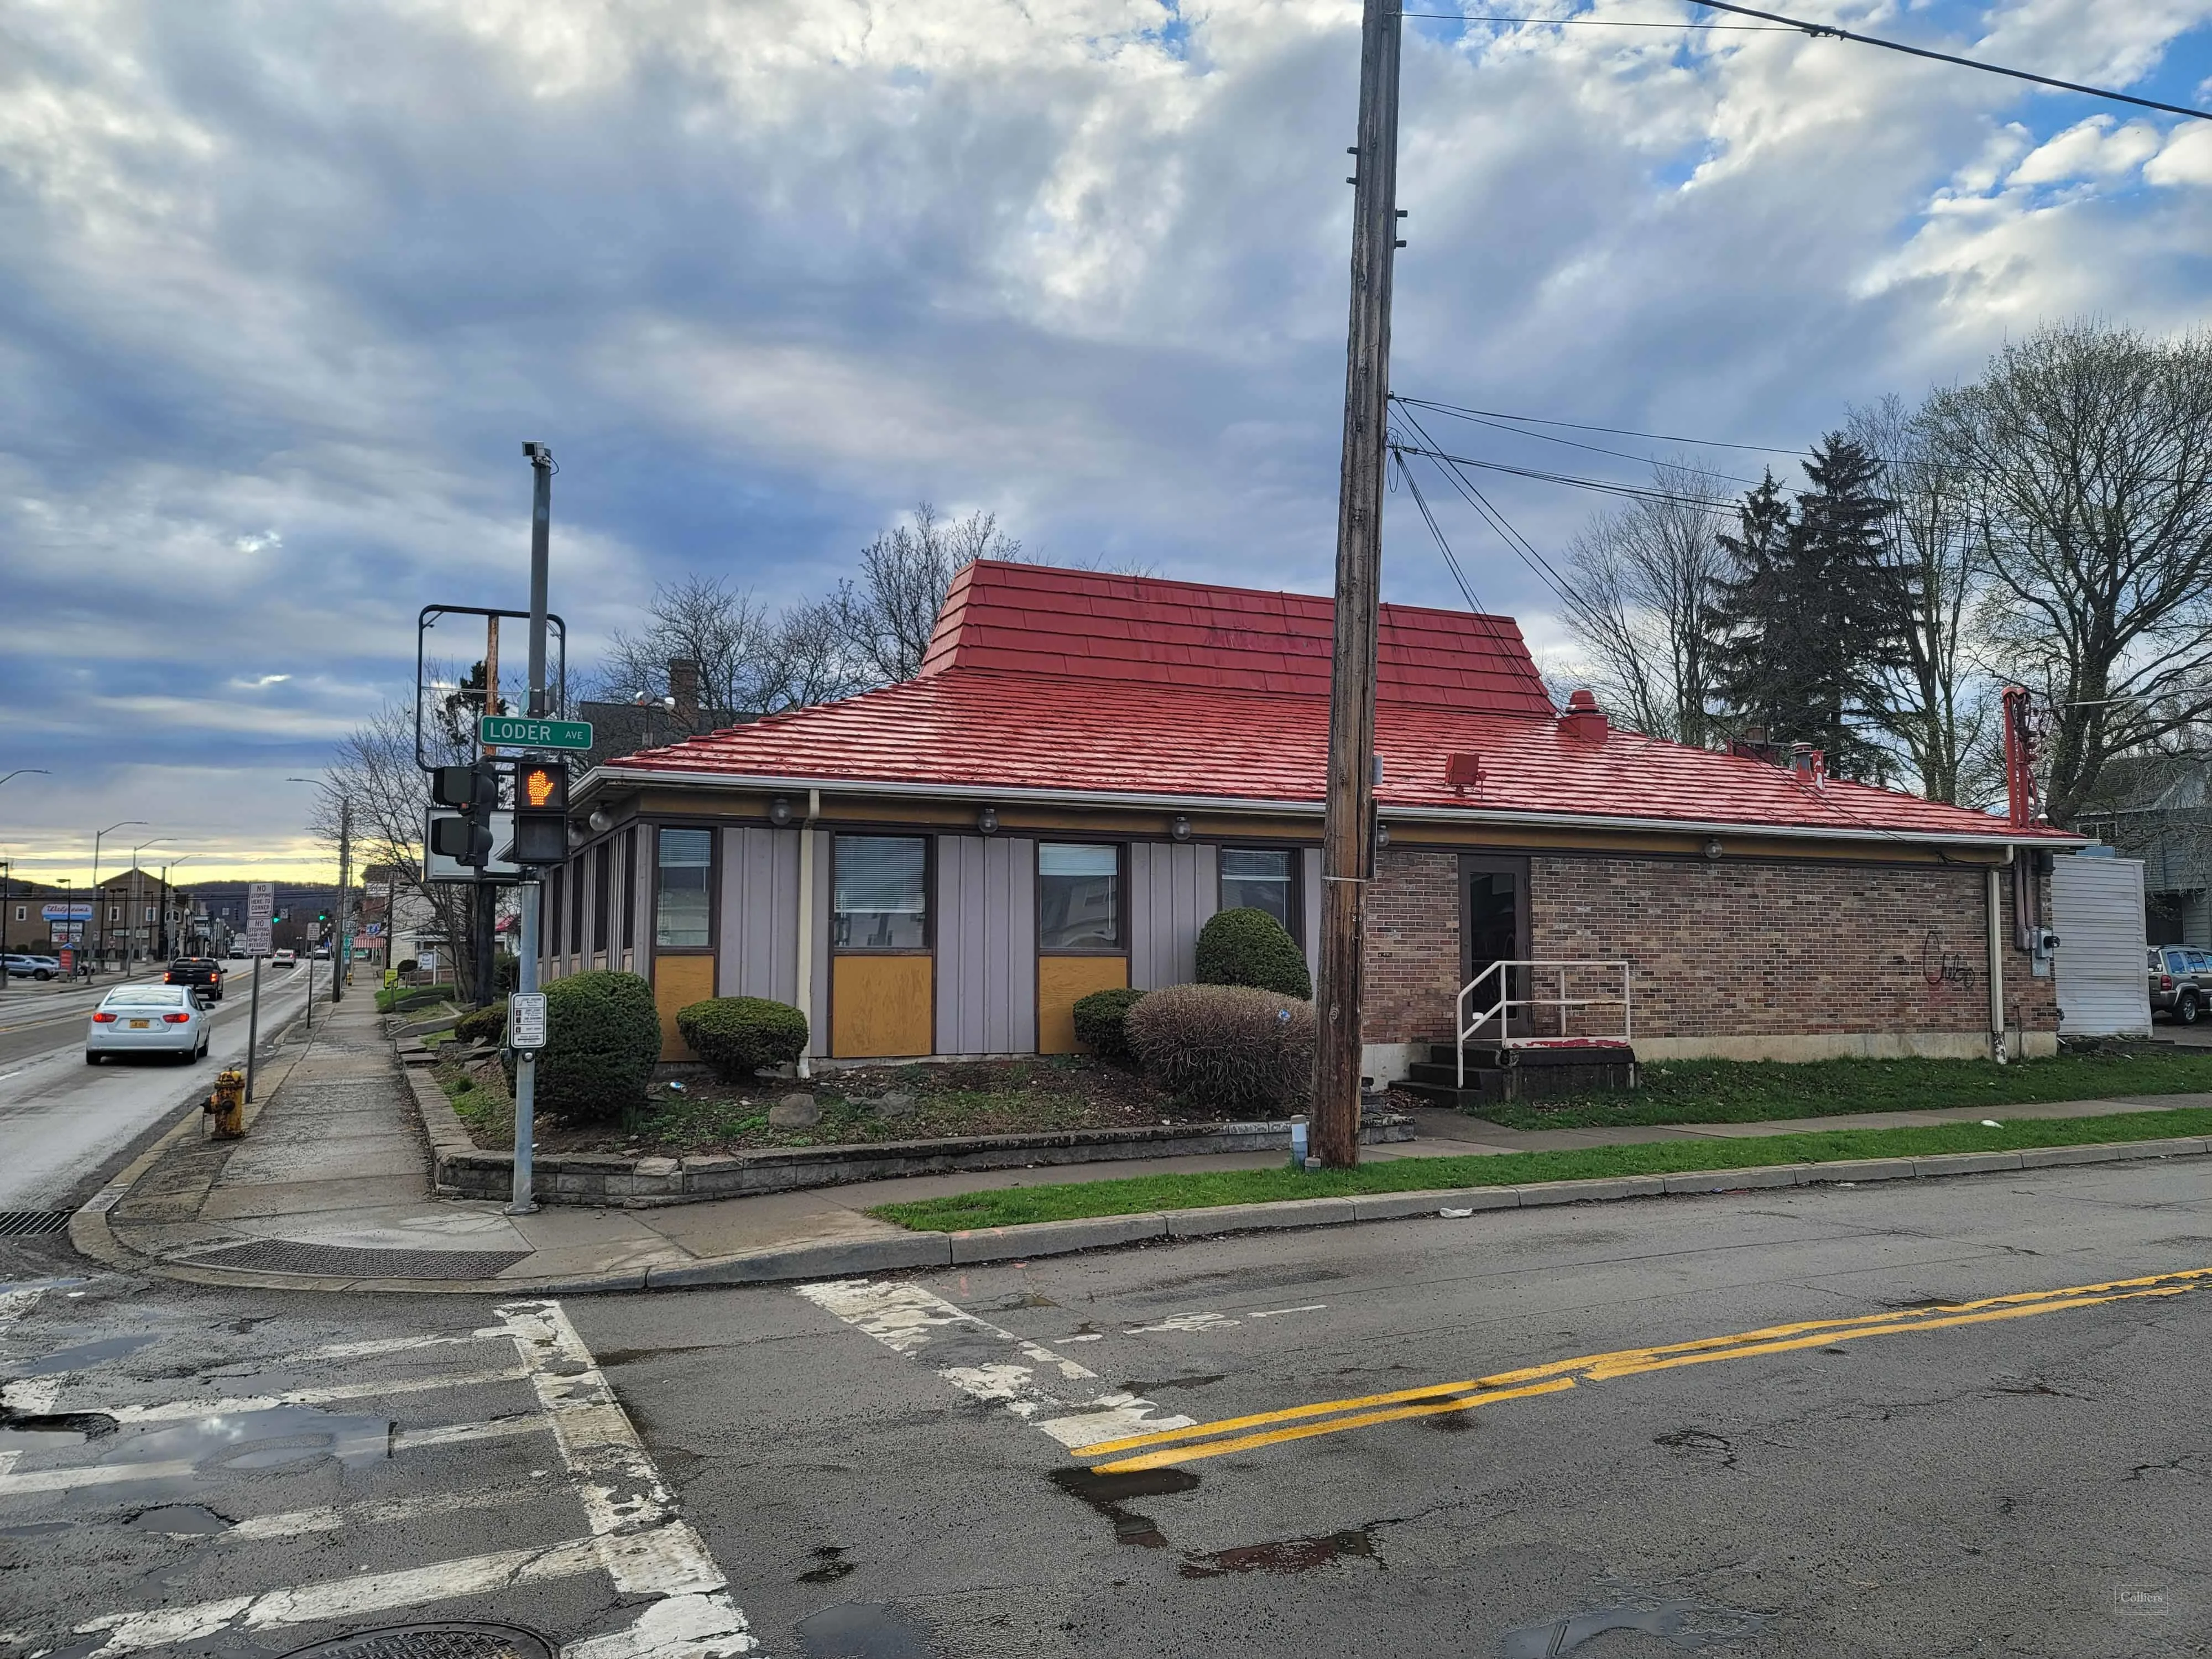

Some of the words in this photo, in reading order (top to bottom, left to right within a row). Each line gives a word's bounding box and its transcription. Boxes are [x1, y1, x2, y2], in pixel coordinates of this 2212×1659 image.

[490, 722, 551, 741] LODER
[565, 731, 583, 739] AVE
[47, 905, 90, 914] Walgeens
